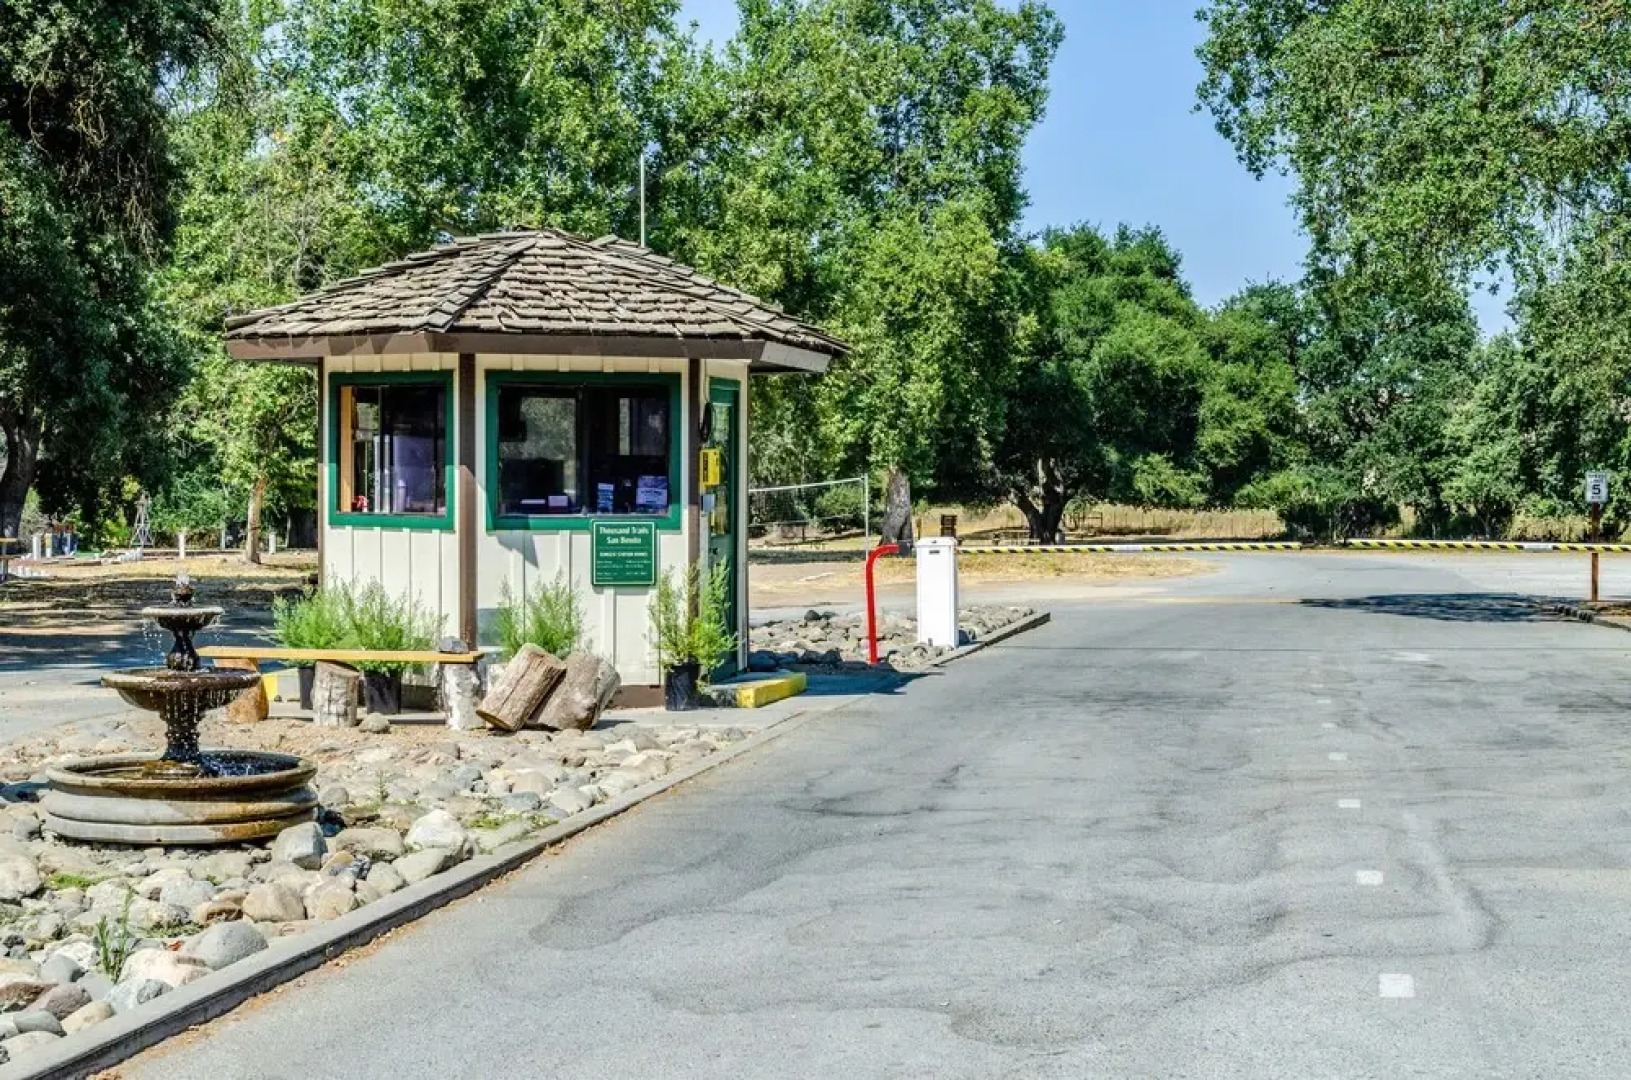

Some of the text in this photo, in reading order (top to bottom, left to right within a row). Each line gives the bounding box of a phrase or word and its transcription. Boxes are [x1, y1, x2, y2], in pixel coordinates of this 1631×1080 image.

[1591, 484, 1601, 495] 5
[599, 526, 650, 535] Thousand Trails
[606, 536, 642, 544] San Benito
